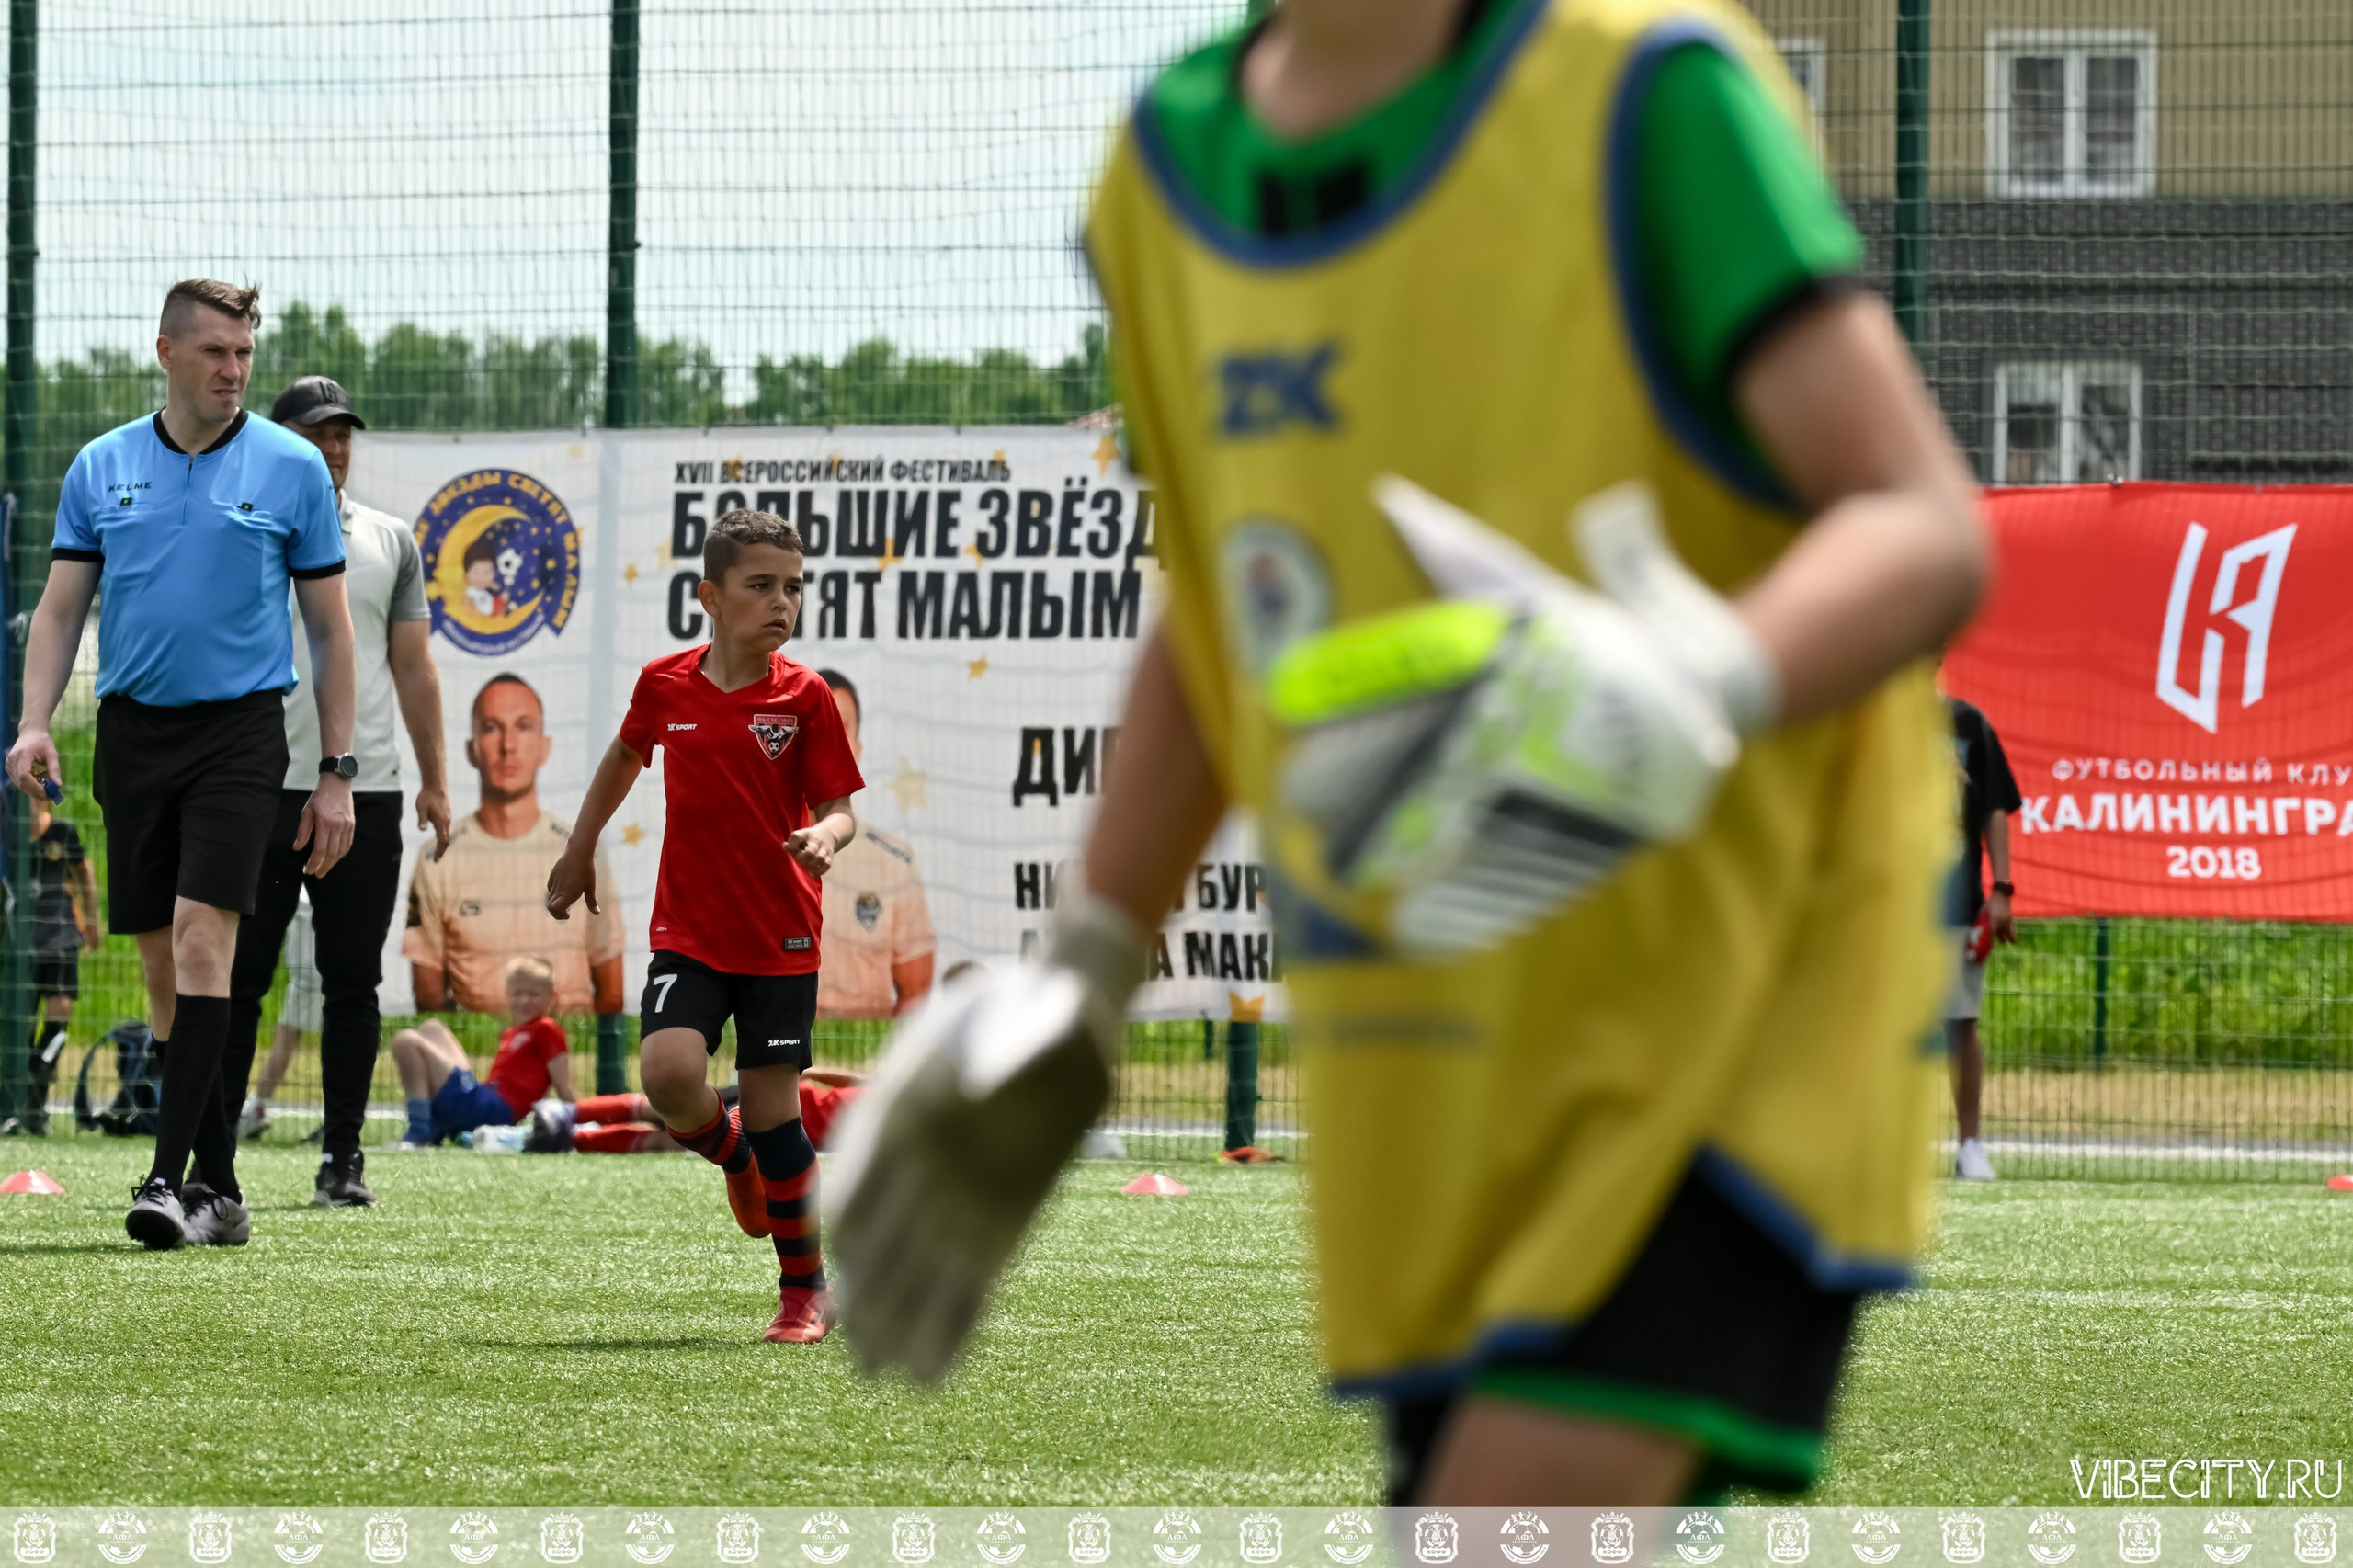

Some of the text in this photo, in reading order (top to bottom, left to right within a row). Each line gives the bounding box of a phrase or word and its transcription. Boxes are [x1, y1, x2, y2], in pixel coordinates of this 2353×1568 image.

[674, 455, 1011, 484] XVII ВСЕРОССИЙСКИЙ ФЕСТИВАЛЬ
[108, 482, 153, 493] KELME
[667, 570, 1142, 640] СТЯТ МАЛЫМ
[2052, 757, 2353, 787] ФУТБОЛЬНЫЙ КЛУ
[2166, 846, 2262, 880] 2018
[654, 973, 678, 1014] 7
[779, 1039, 801, 1047] SPORT
